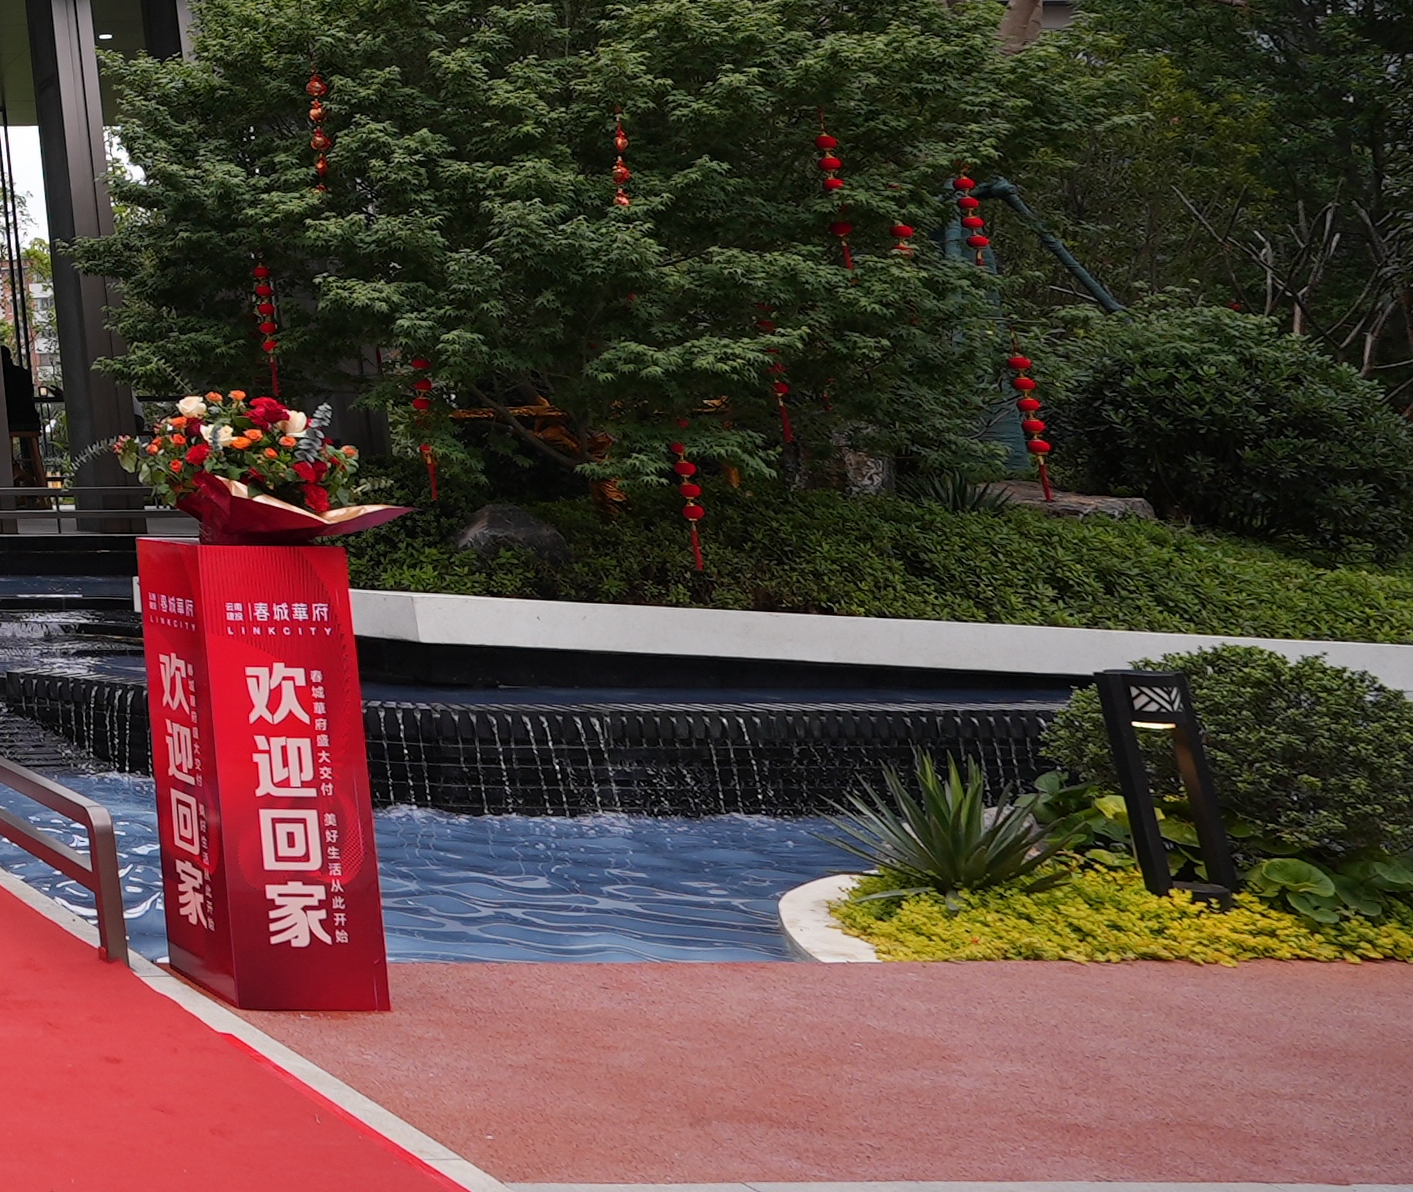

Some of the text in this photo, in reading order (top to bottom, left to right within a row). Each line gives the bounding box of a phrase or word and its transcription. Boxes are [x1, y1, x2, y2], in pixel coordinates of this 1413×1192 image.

[227, 626, 333, 636] LINKCITY
[159, 652, 209, 931] 欢迎回家
[244, 662, 332, 947] 欢迎回家
